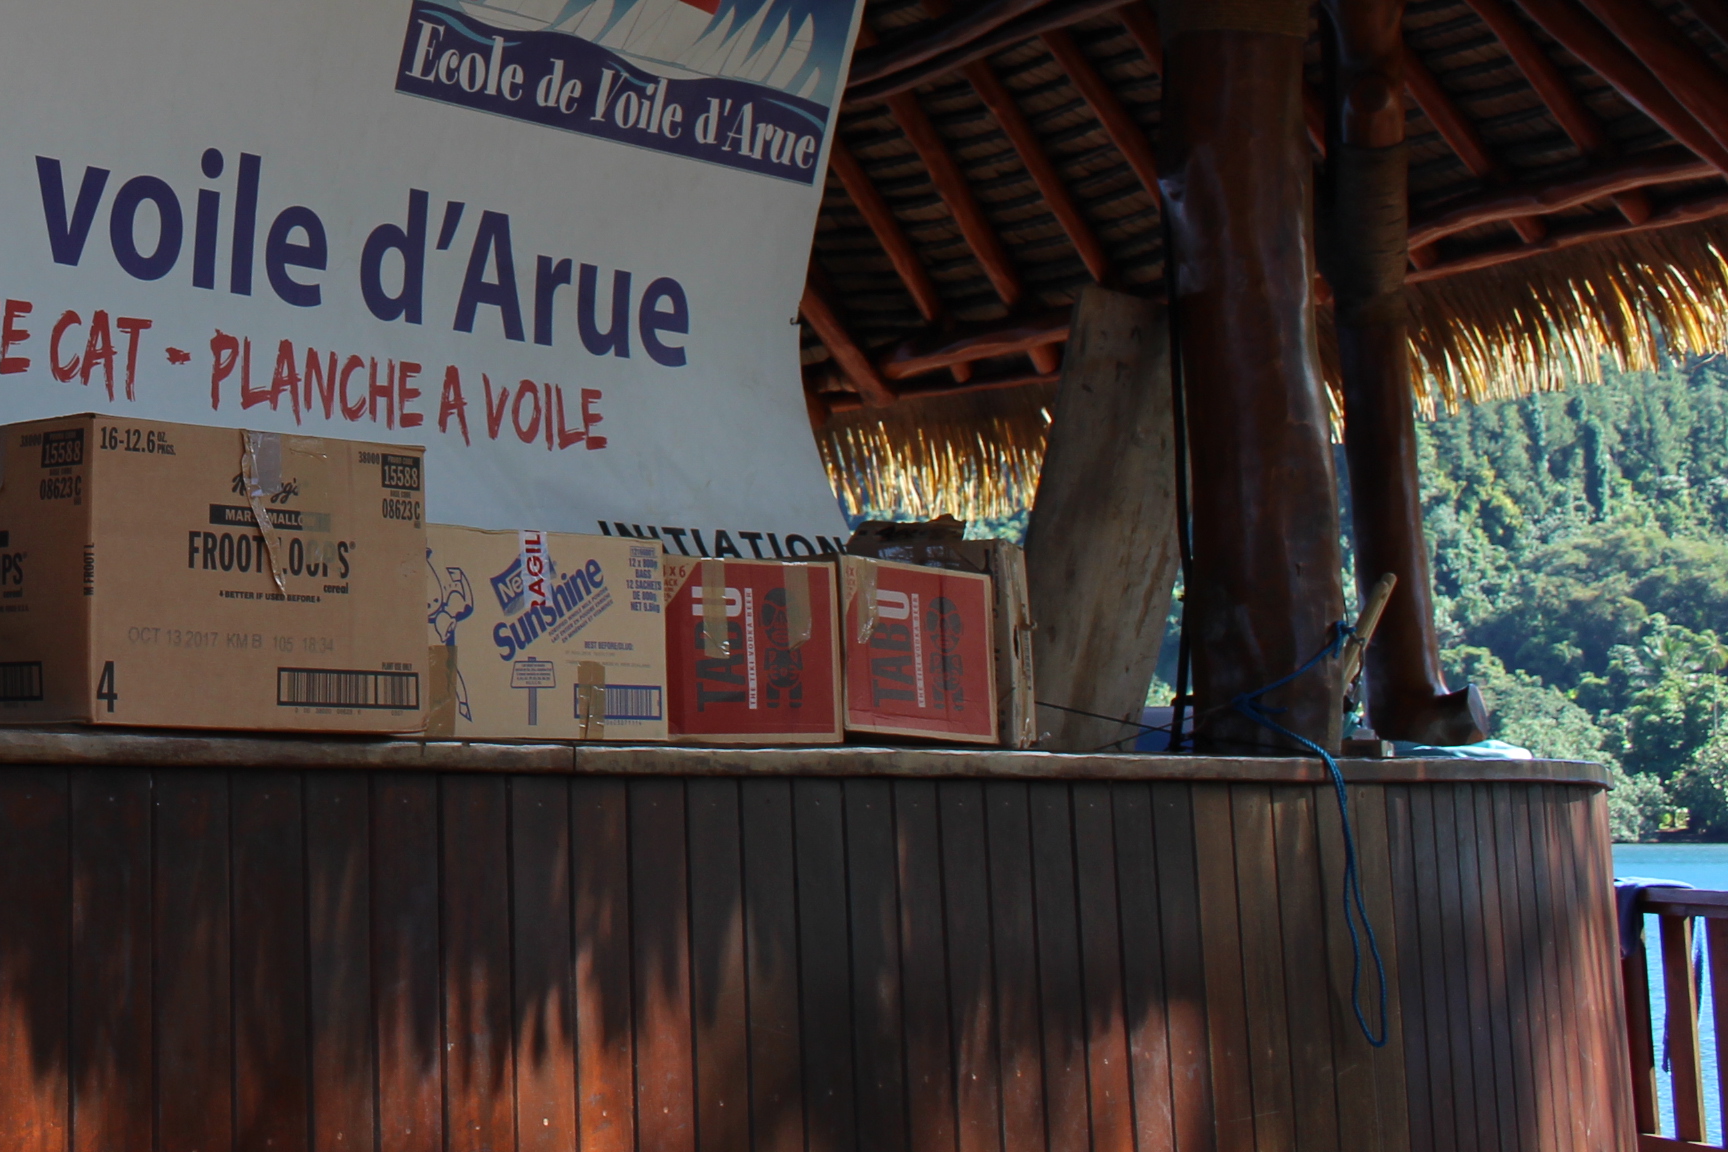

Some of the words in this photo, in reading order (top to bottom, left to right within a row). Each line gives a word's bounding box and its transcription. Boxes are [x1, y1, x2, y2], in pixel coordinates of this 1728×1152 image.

[405, 19, 523, 101] Ecole
[536, 58, 582, 115] de
[590, 66, 682, 140] Voile
[695, 97, 816, 170] d'Arue
[35, 147, 328, 308] voile
[360, 187, 690, 368] d'Arue
[49, 309, 153, 403] CAT
[209, 328, 425, 431] PLANCHE
[438, 365, 471, 448] A
[482, 372, 608, 451] VOILE
[43, 441, 81, 465] 15588
[100, 426, 156, 453] 16-12.6
[384, 465, 418, 487] 15588
[188, 530, 265, 573] FROOT
[225, 590, 254, 599] BETTER
[256, 592, 263, 600] IF
[265, 593, 285, 601] USED
[287, 595, 316, 603] BEFORE
[324, 582, 349, 594] cereal
[664, 578, 678, 586] ACK
[493, 559, 603, 661] Sunshine
[128, 626, 161, 645] OCT
[166, 629, 182, 647] 13
[185, 631, 219, 649] 2017
[691, 586, 746, 712] TABU
[871, 589, 915, 707] TABU
[97, 660, 118, 713] 4
